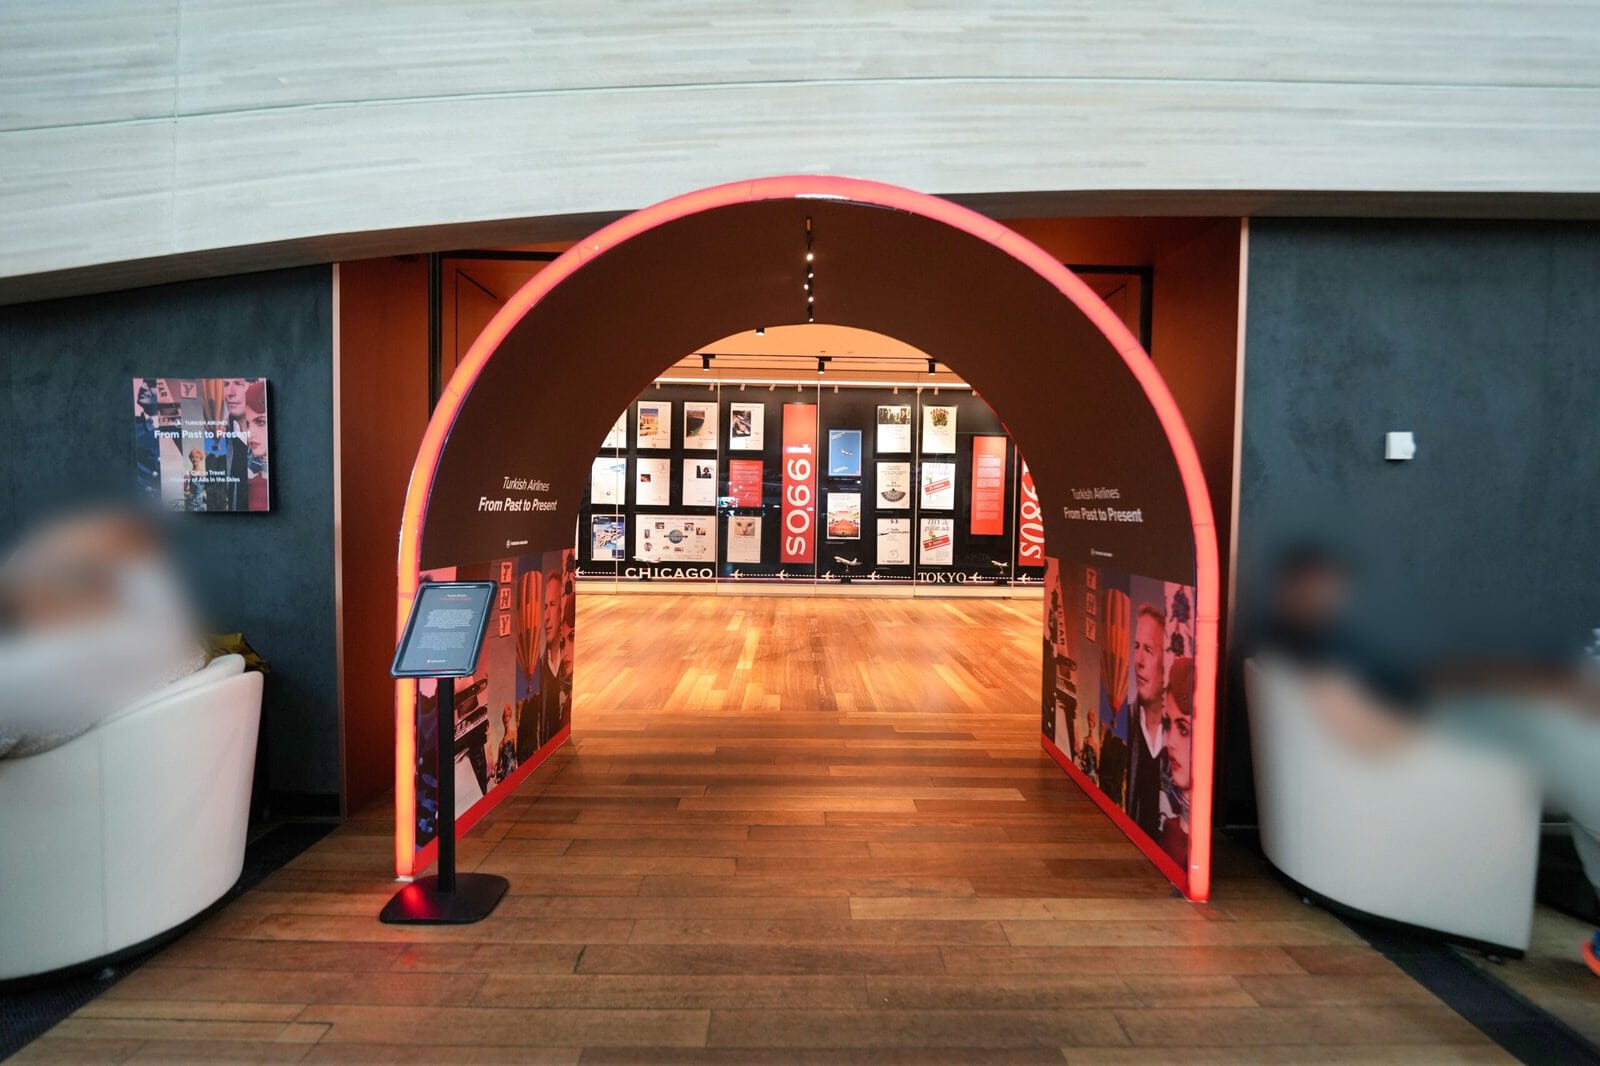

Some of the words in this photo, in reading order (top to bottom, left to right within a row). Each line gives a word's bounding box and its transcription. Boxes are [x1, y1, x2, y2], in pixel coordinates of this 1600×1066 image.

[154, 430, 180, 439] From
[182, 430, 203, 439] Past
[204, 430, 215, 439] to
[216, 430, 251, 439] Present
[503, 476, 527, 490] Turkish
[527, 479, 550, 492] Airlines
[1071, 488, 1093, 500] Turkish
[1093, 487, 1120, 499] Airlines
[478, 496, 503, 512] From
[503, 497, 523, 512] Past
[523, 499, 531, 512] to
[531, 499, 557, 512] Present
[1063, 506, 1081, 520] From
[1081, 507, 1098, 521] Past
[1098, 508, 1107, 521] to
[1107, 507, 1144, 522] Present
[624, 567, 713, 580] CHICAGO
[917, 571, 967, 583] TOKYO
